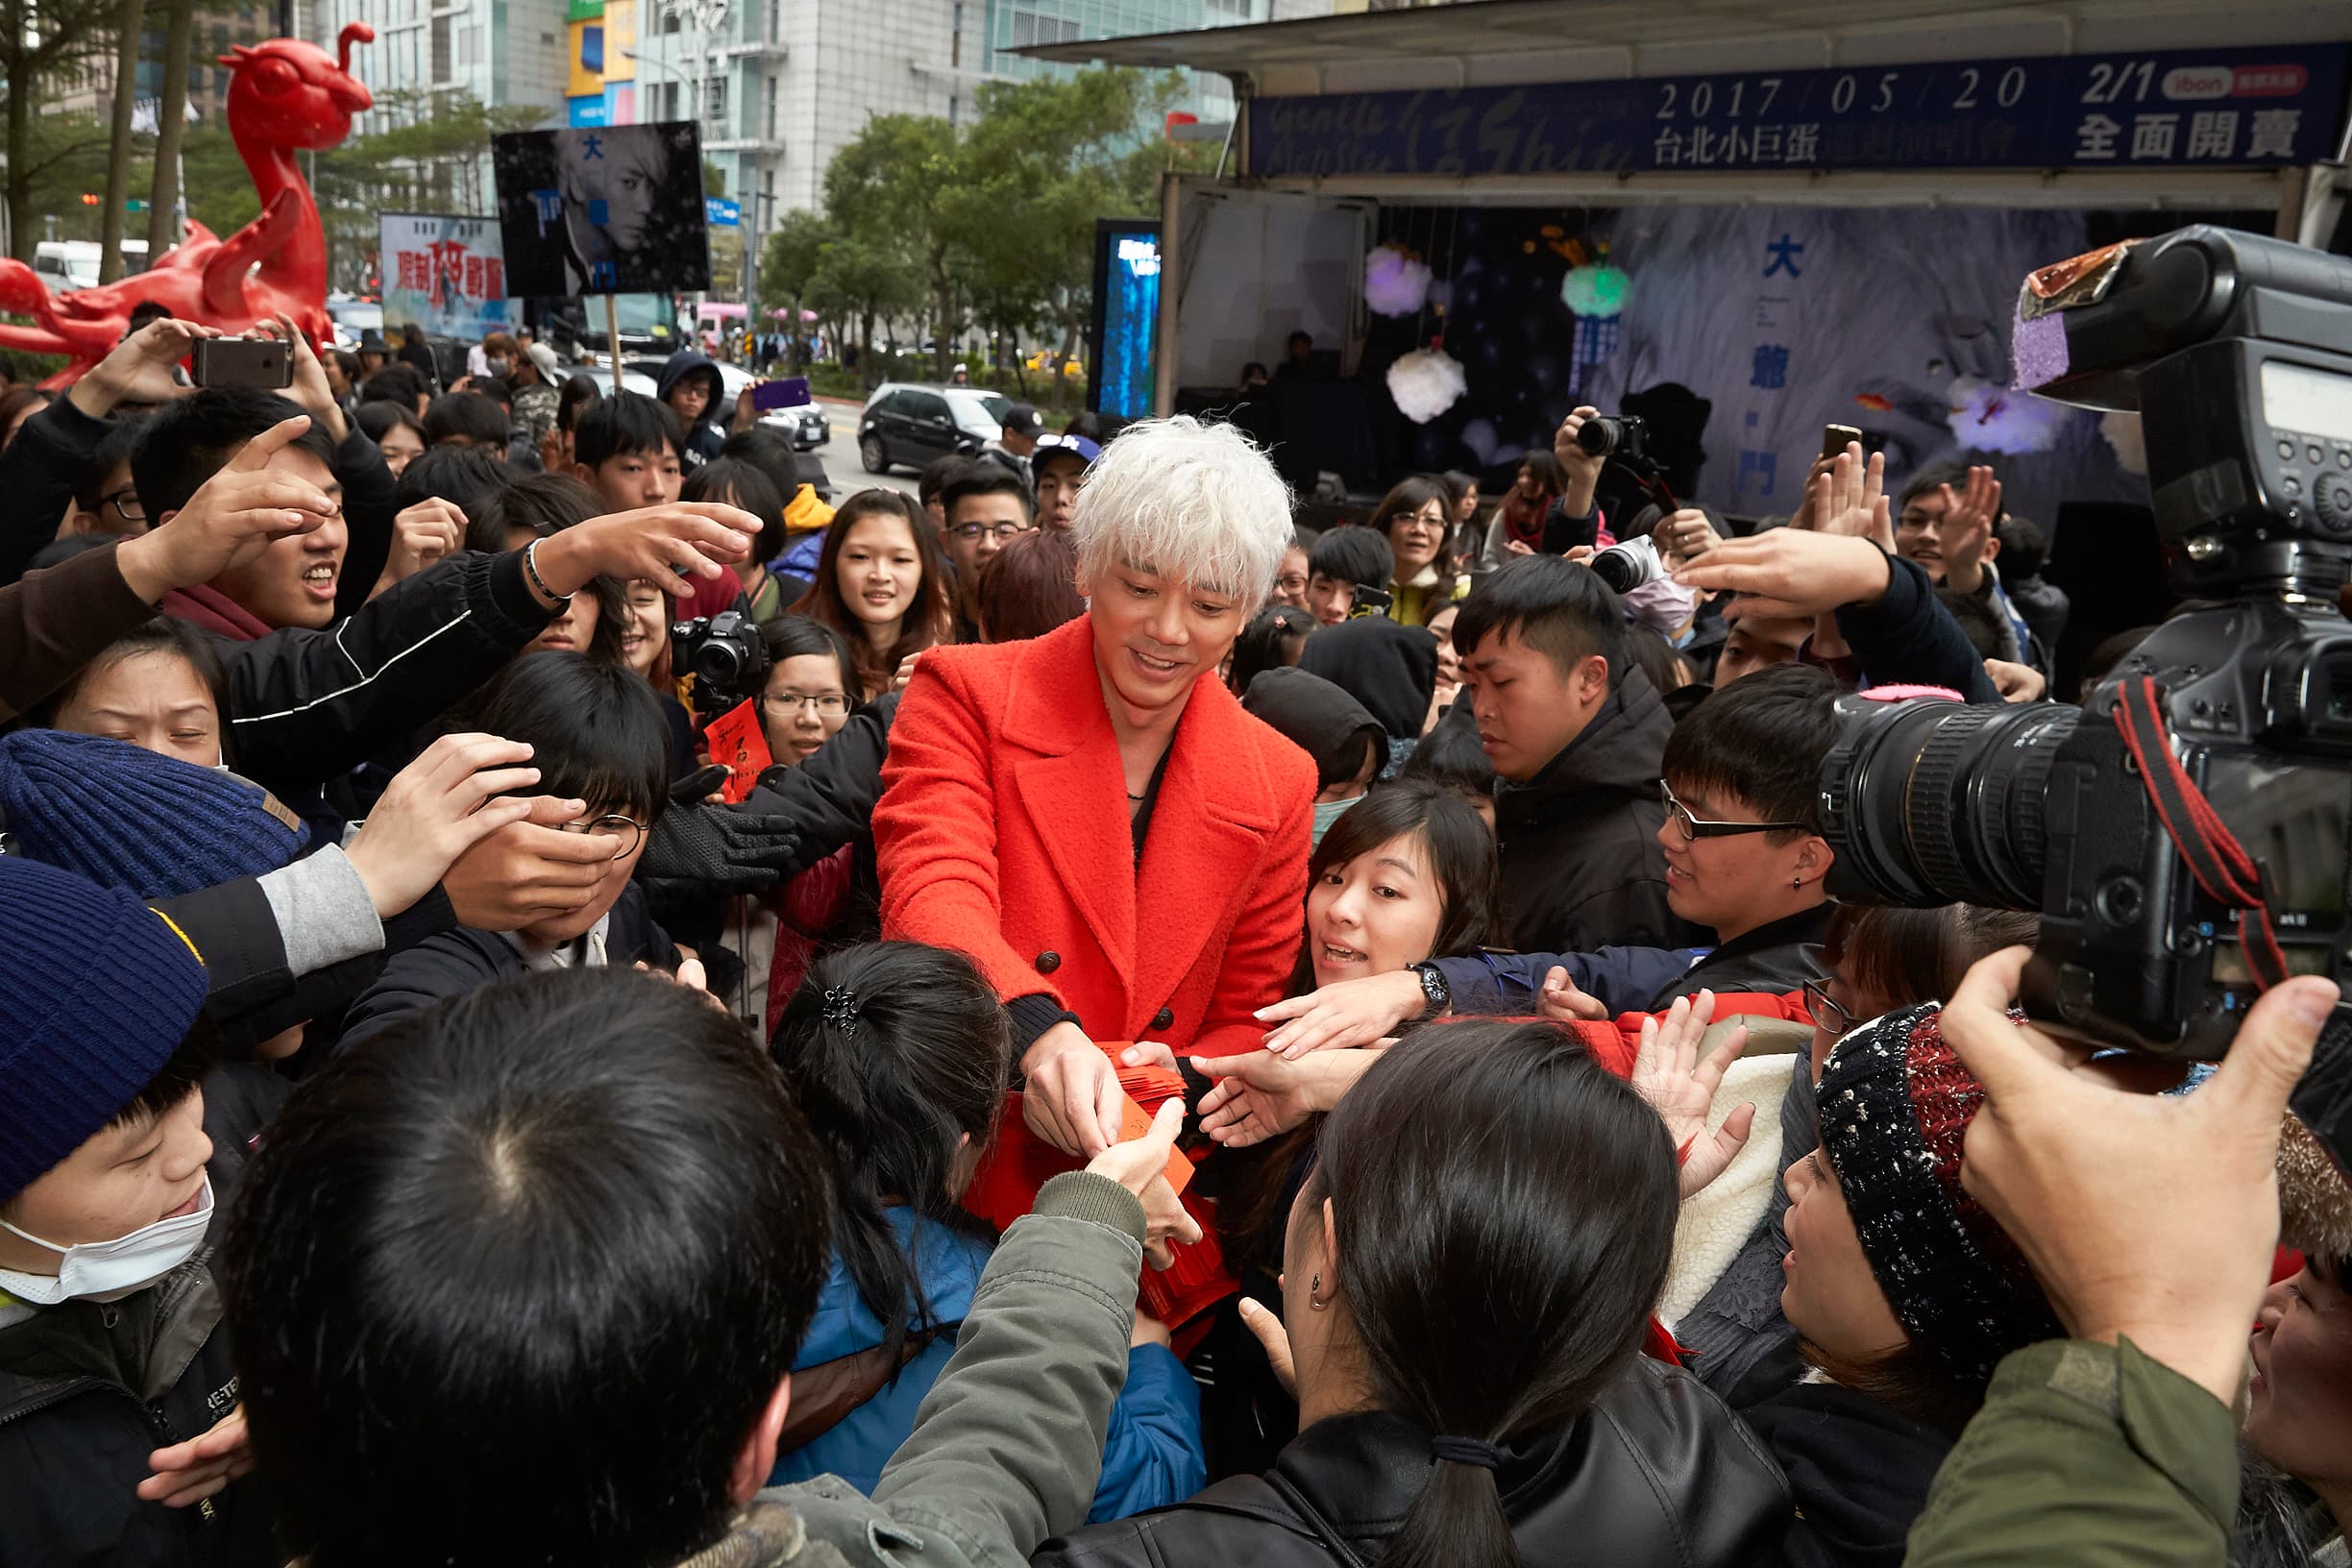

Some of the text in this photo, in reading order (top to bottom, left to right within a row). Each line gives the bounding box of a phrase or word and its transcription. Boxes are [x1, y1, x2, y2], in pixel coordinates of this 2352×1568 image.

[1655, 79, 1781, 119] 2017
[2080, 61, 2156, 104] 2/1
[2074, 109, 2302, 159] 全面開賣
